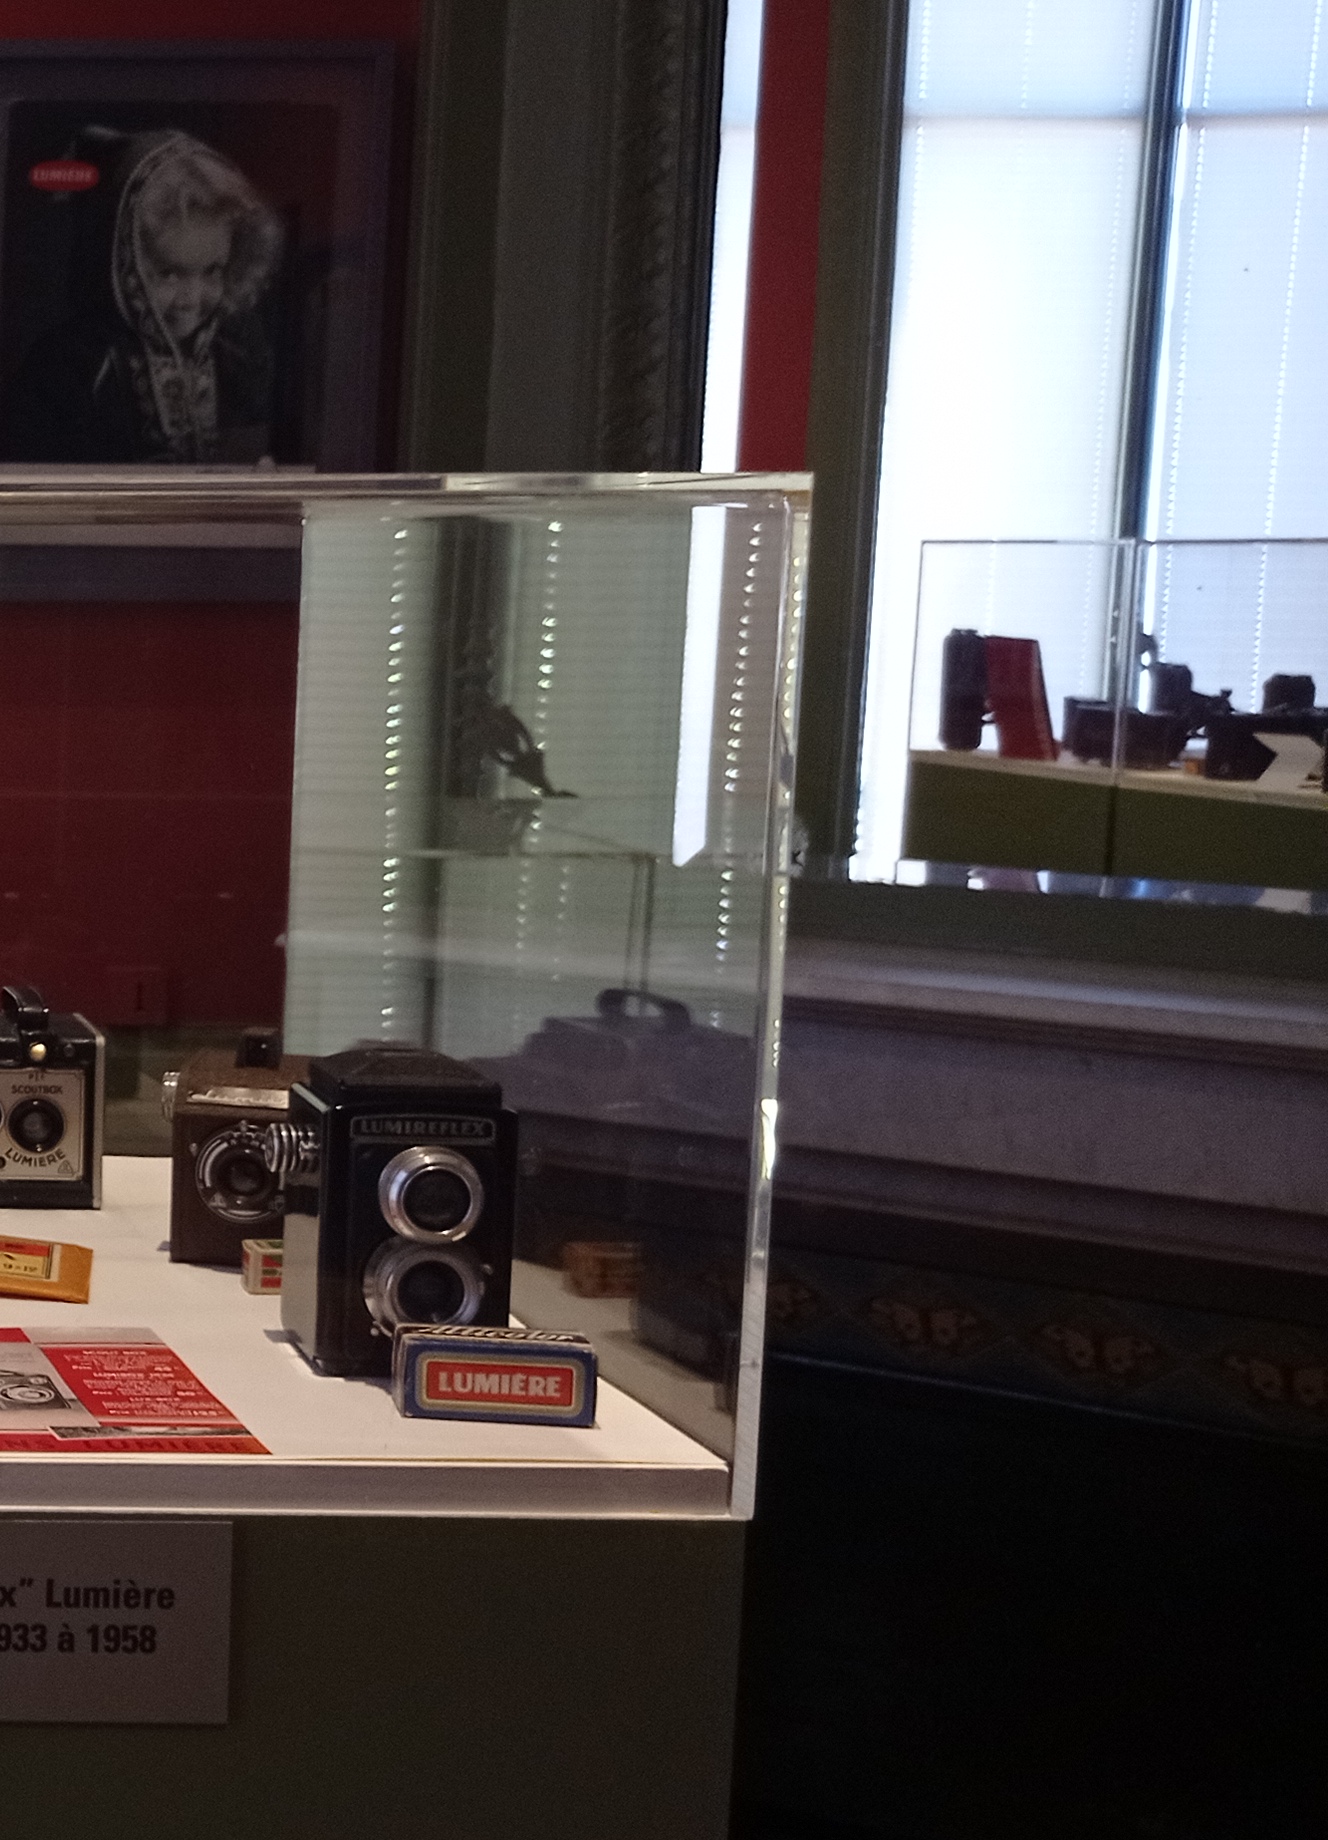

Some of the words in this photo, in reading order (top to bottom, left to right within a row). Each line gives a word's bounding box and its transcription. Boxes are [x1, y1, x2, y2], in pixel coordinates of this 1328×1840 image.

[361, 1119, 484, 1135] LUMIREFLEX
[45, 1579, 176, 1611] Lumière
[57, 1624, 76, 1653] à
[87, 1625, 157, 1654] 1958
